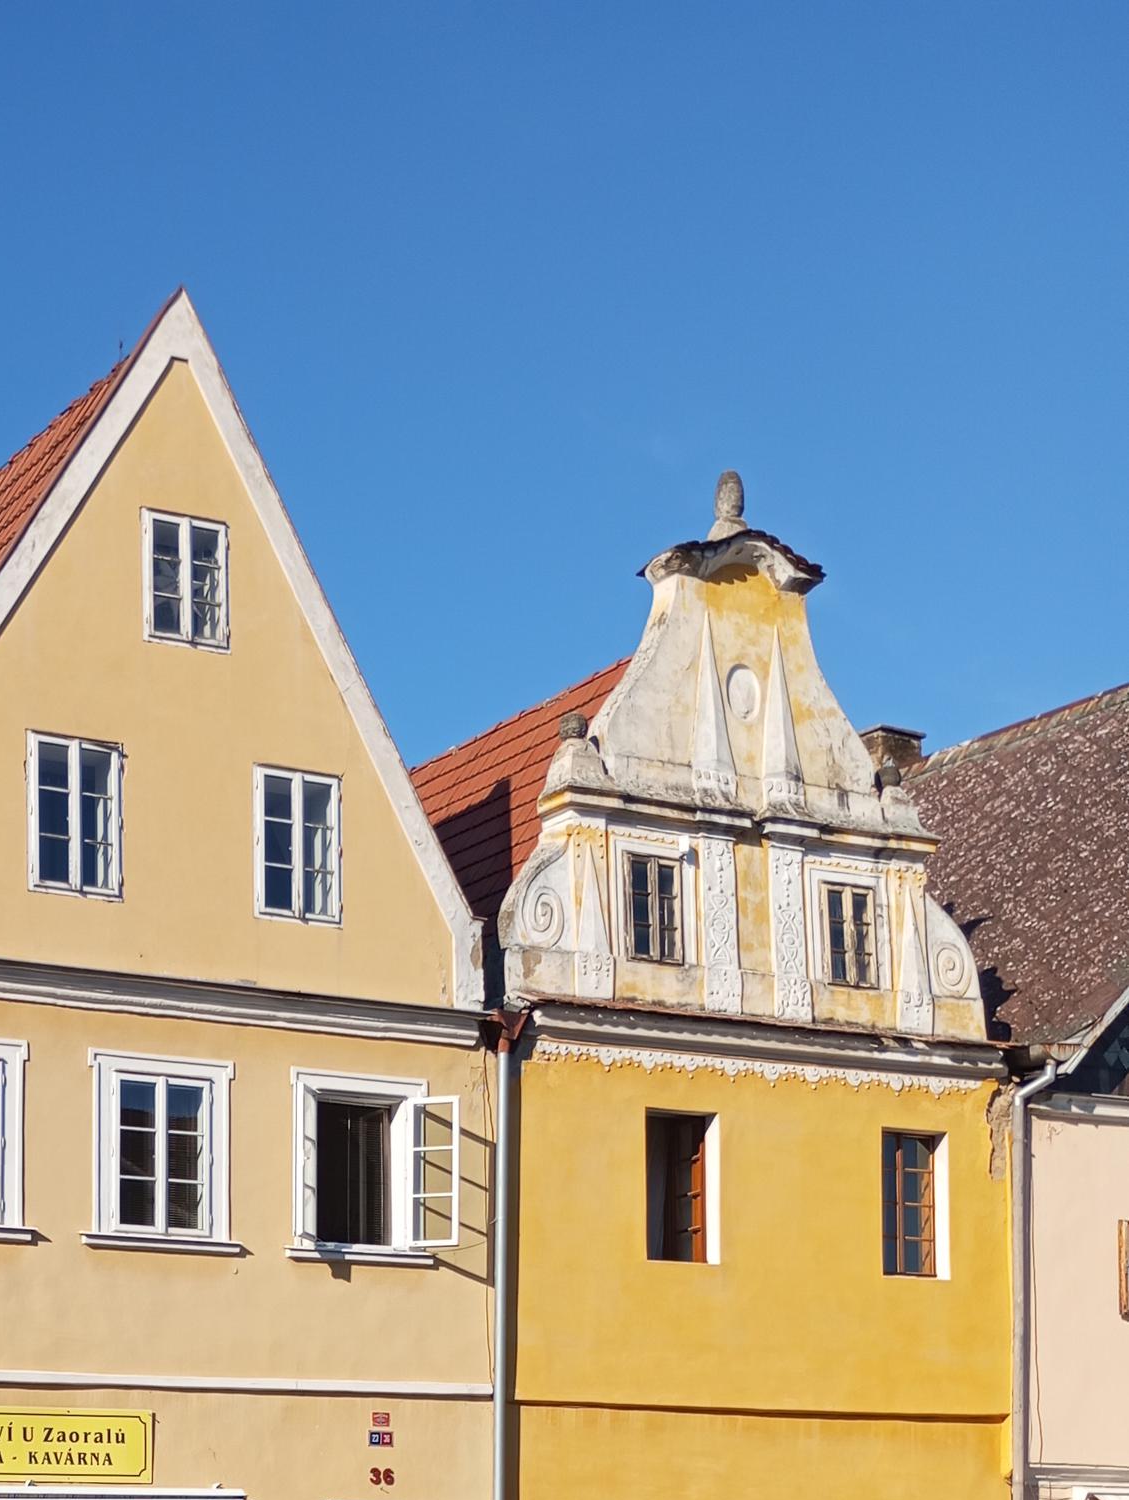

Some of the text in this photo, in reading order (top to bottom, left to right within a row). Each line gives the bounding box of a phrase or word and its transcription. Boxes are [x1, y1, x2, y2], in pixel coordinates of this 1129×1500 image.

[22, 1426, 34, 1442] U
[43, 1427, 126, 1444] Zaoralů
[28, 1448, 114, 1466] KAVÁRNA
[369, 1467, 395, 1486] 36
